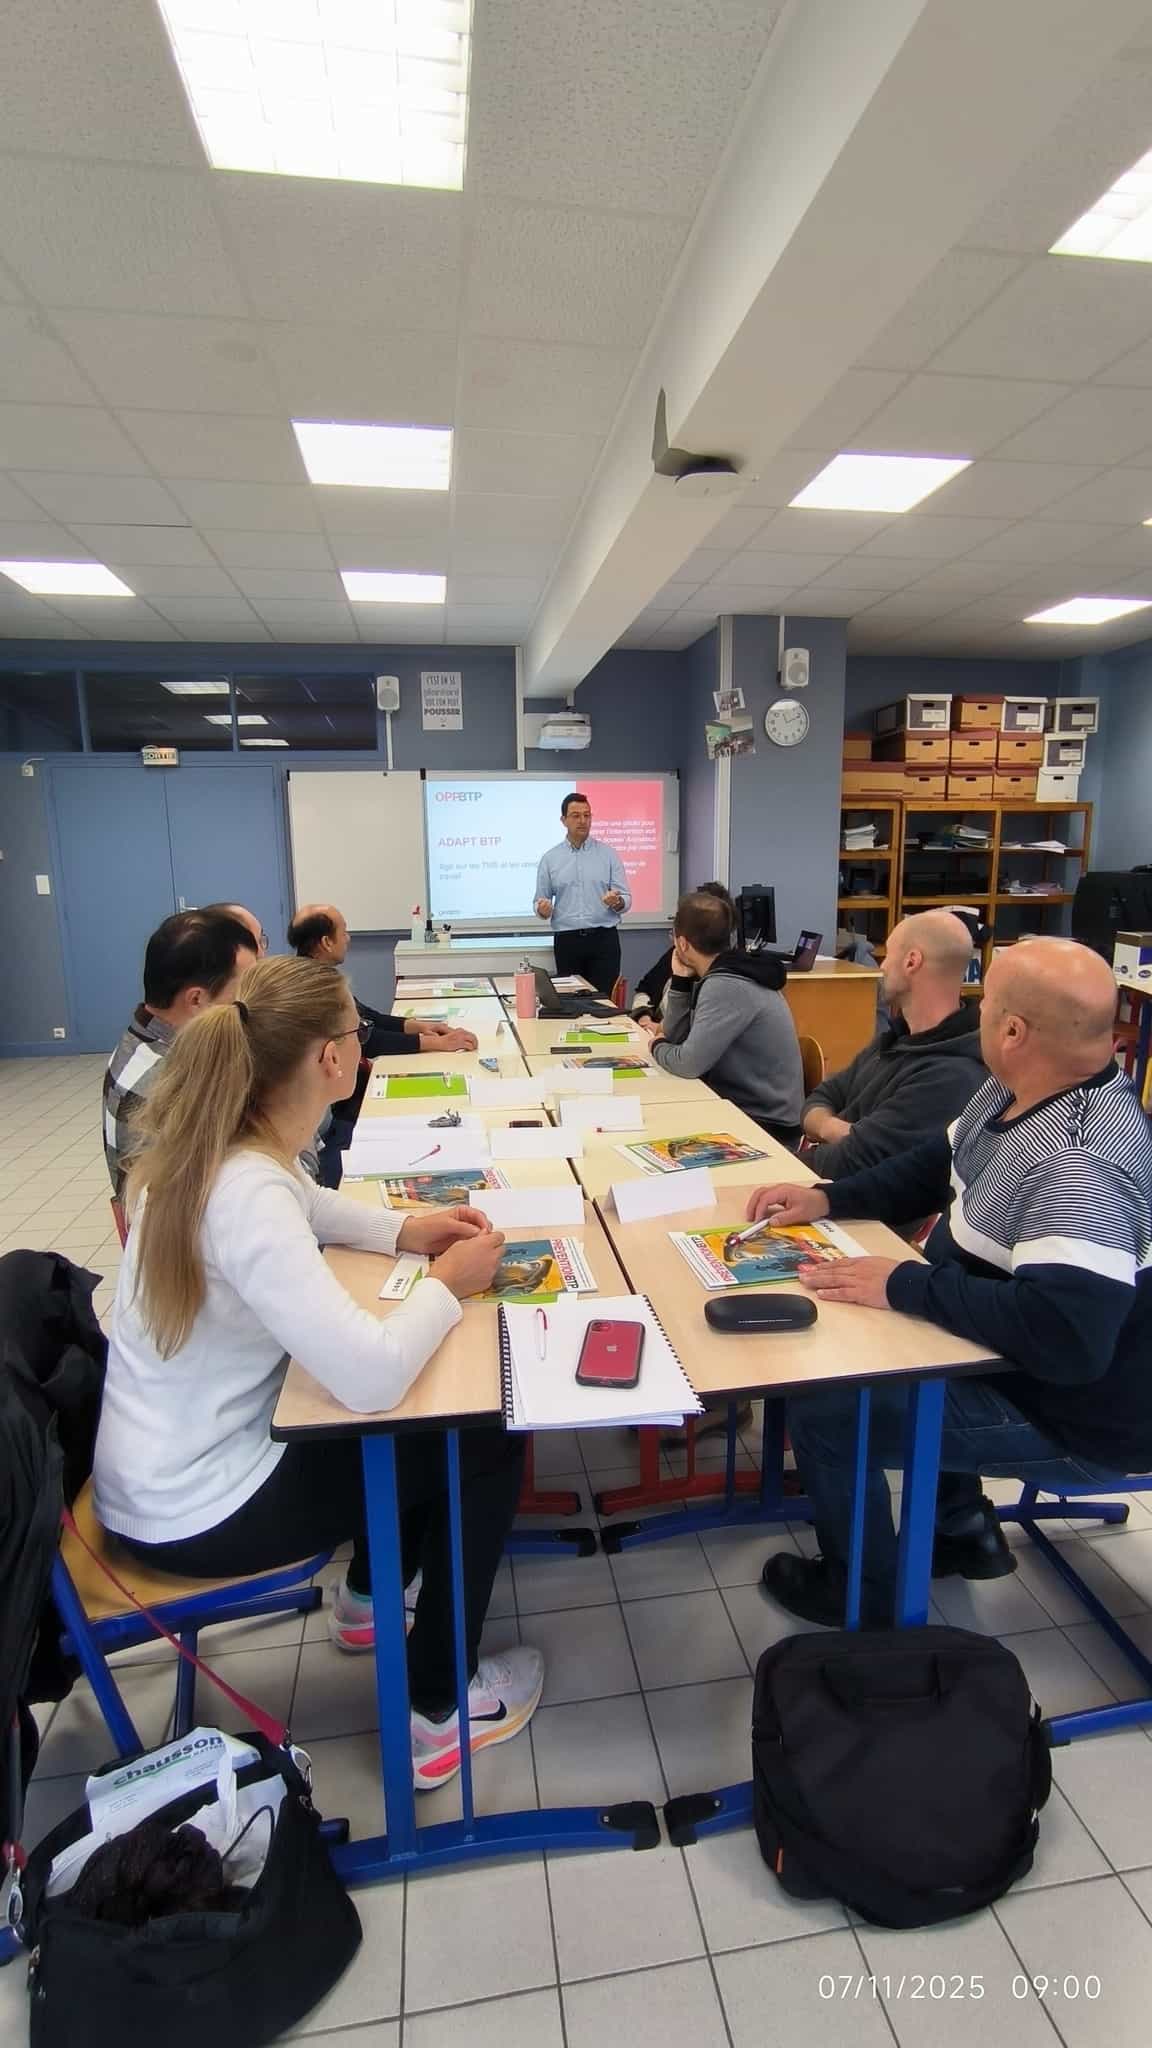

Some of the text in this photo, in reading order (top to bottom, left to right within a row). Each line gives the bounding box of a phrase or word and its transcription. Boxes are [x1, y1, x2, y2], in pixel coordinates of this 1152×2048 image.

[143, 751, 176, 760] SORTIE
[438, 836, 501, 847] ADAPT BTP
[113, 1735, 223, 1786] chausson
